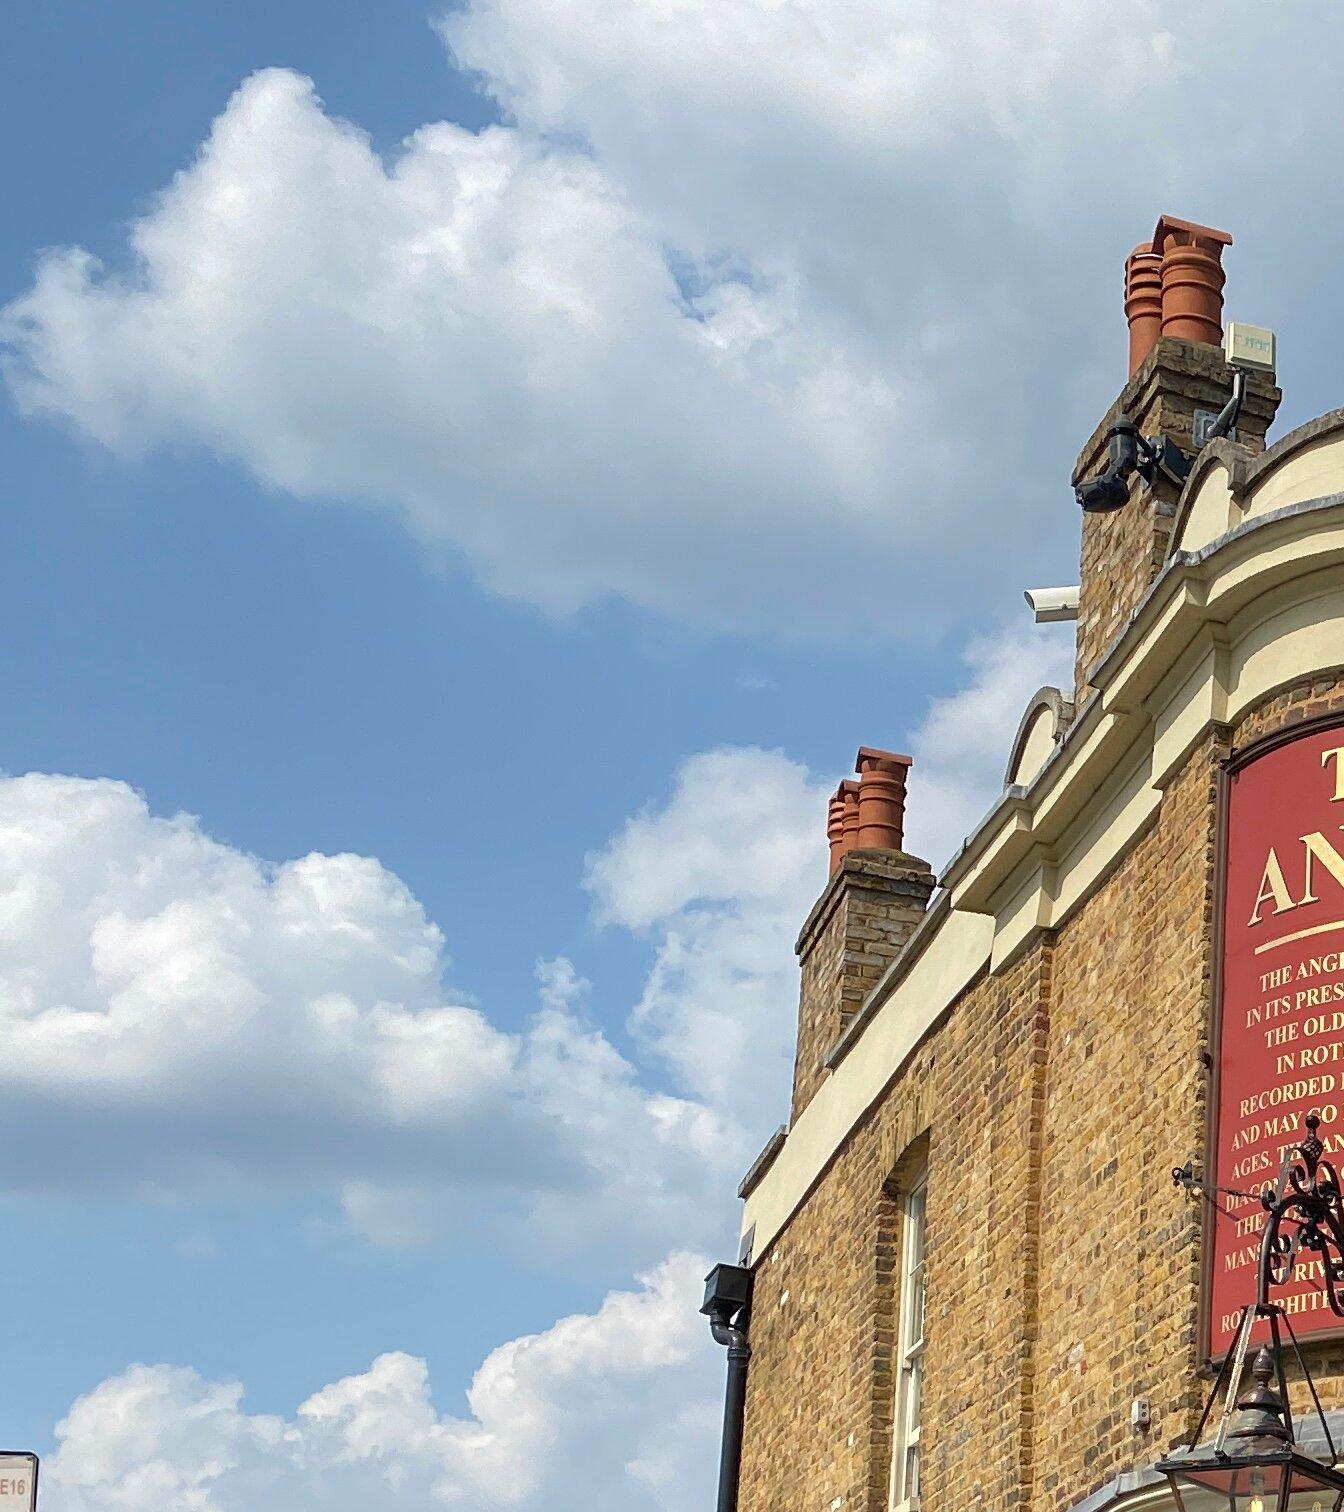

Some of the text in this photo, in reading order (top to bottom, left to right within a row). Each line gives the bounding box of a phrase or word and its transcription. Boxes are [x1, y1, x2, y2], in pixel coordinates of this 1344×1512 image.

[1259, 964, 1292, 993] THE
[1246, 1005, 1262, 1029] IN
[1265, 995, 1291, 1021] ITS
[1264, 1021, 1299, 1049] THE
[1276, 1052, 1295, 1076] IN
[1239, 1073, 1336, 1119] RECORDED
[1230, 1123, 1261, 1152] AND
[1263, 1110, 1303, 1138] MAY
[1230, 1150, 1273, 1182] AGES.
[1276, 1140, 1303, 1164] TH
[1234, 1211, 1264, 1240] THE
